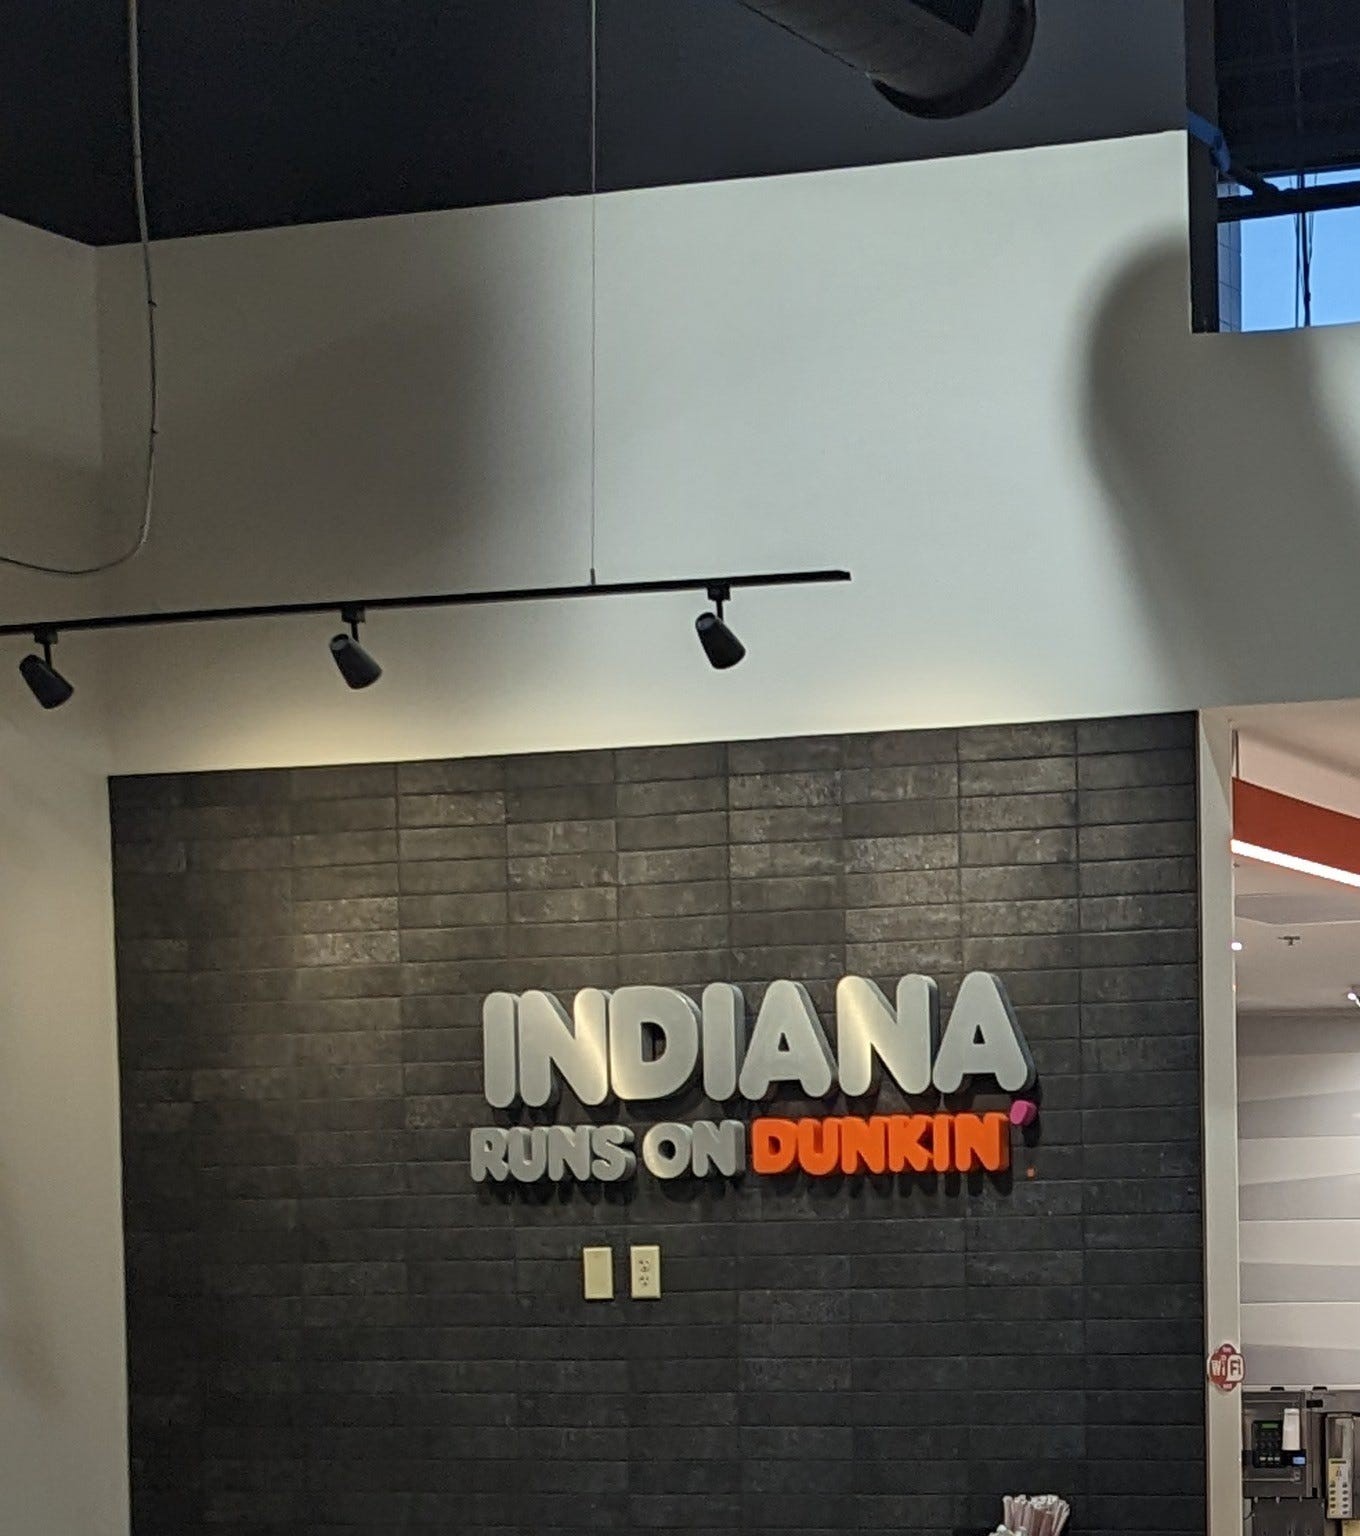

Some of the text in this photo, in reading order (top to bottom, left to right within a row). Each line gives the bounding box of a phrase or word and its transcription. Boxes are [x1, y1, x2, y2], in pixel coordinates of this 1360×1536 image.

[483, 970, 1038, 1109] INDIANA
[470, 1100, 1036, 1183] RUNS ON DUNKIN'
